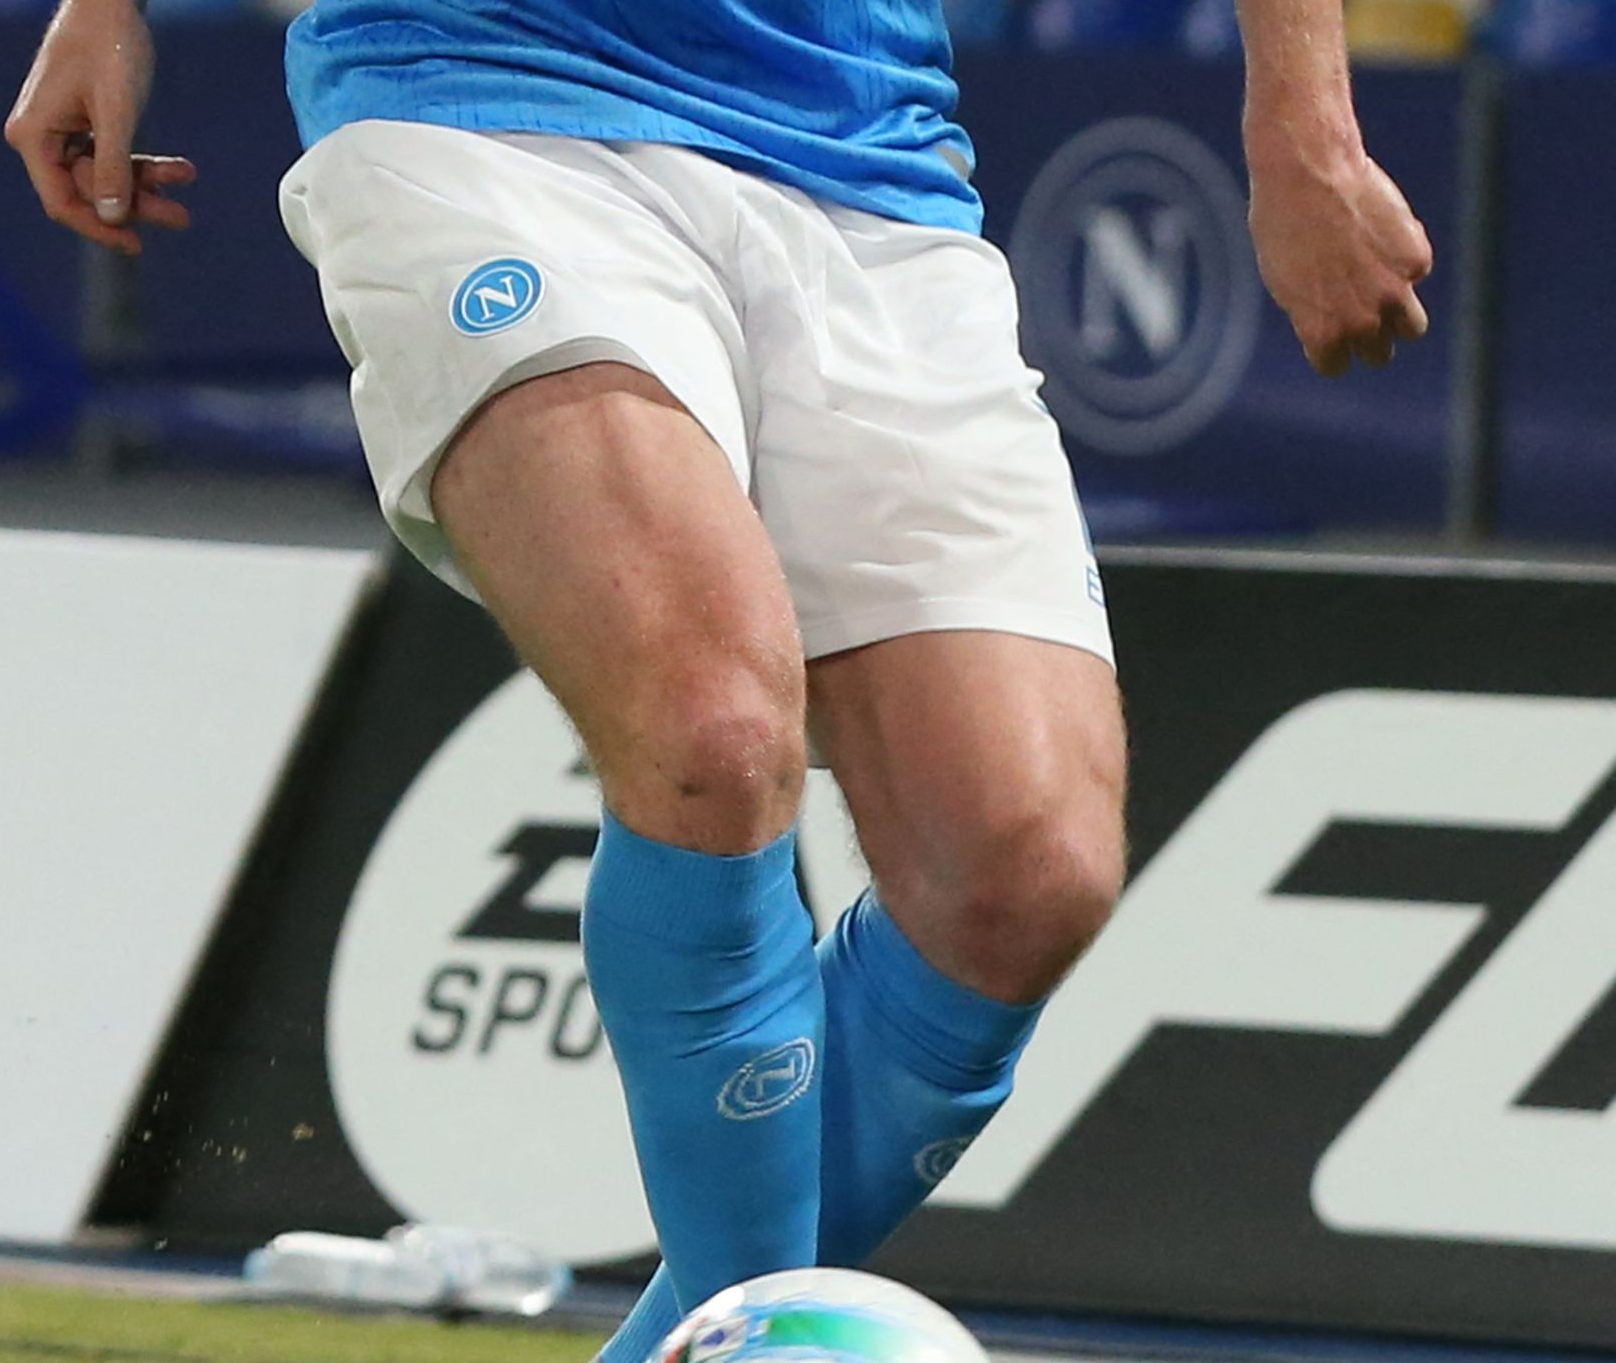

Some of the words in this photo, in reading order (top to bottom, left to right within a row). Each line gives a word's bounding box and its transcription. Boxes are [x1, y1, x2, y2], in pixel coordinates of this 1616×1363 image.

[473, 274, 518, 322] N
[1077, 200, 1197, 361] N
[411, 963, 606, 1061] SPO
